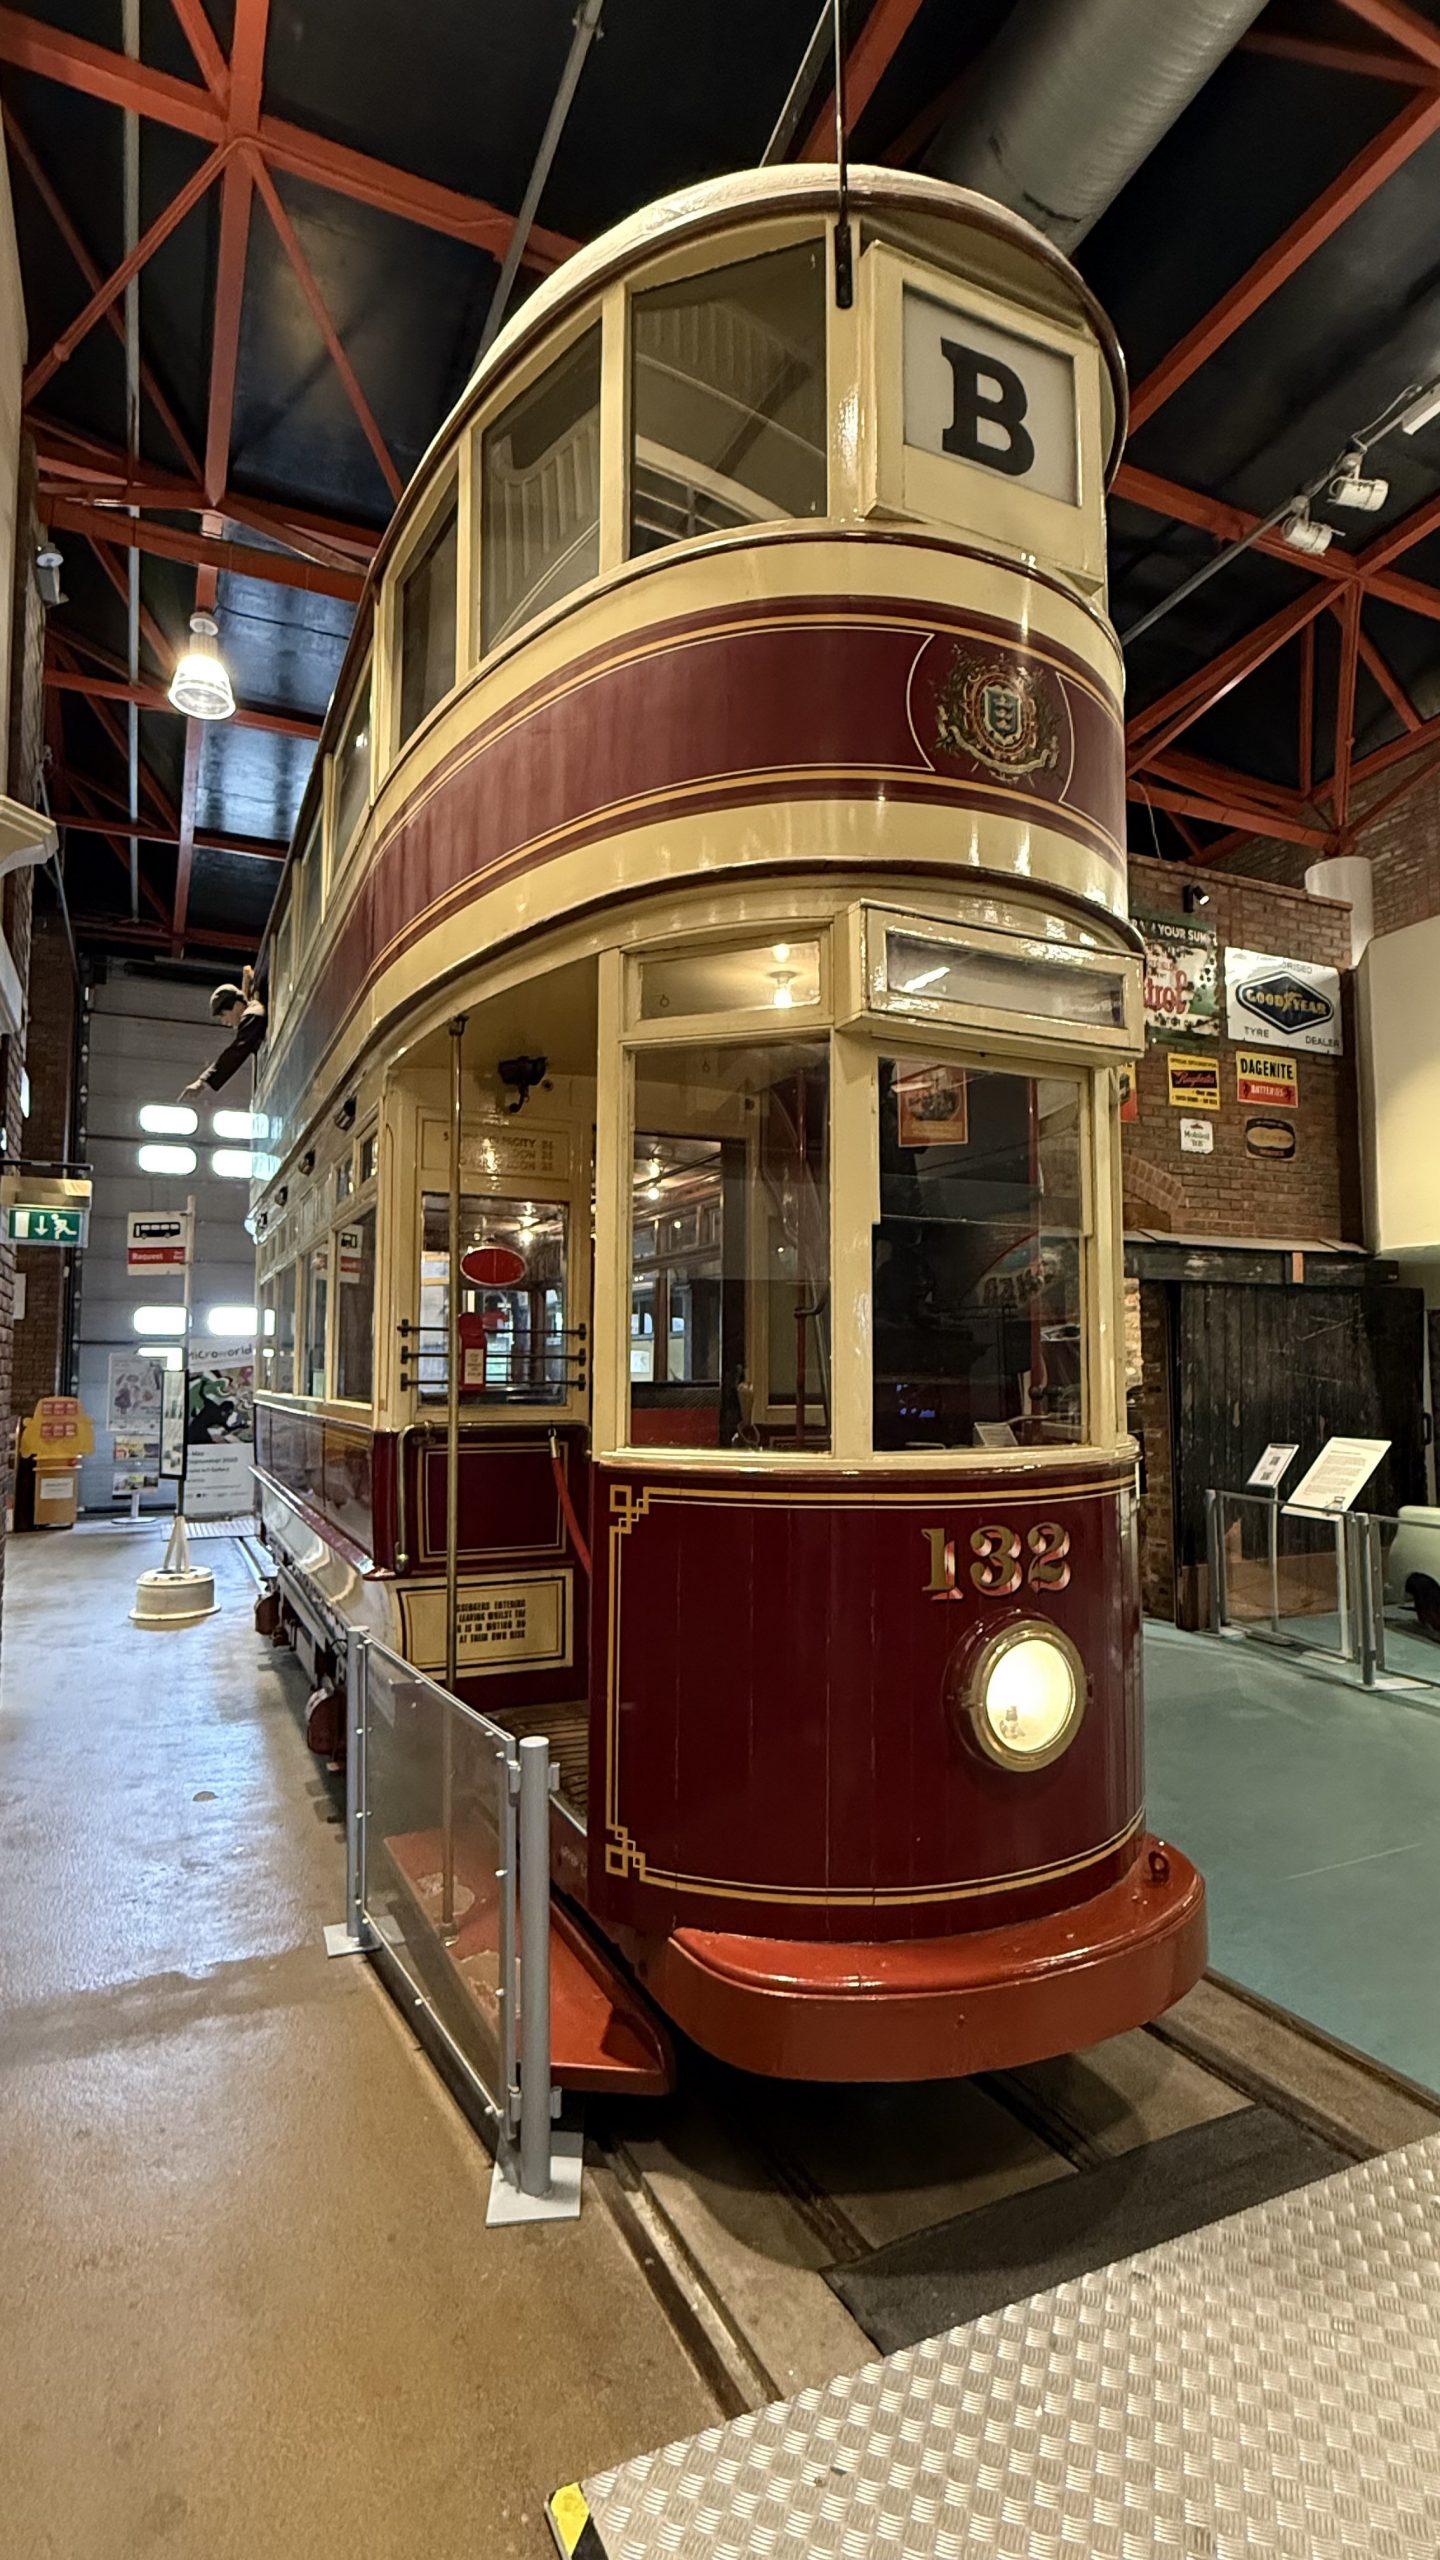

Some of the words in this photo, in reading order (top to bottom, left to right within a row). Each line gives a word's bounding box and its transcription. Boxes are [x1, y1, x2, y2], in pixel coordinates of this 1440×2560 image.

[940, 336, 1035, 477] B
[1157, 923, 1186, 940] YOUR
[1245, 988, 1327, 1016] GOODYEAR
[1244, 1026, 1270, 1038] TYRE
[1305, 1035, 1340, 1048] DEALER
[1240, 1058, 1294, 1080] DAGENITE
[132, 1252, 164, 1261] Request
[920, 1521, 1072, 1601] 132
[457, 1602, 490, 1612] SSENGERS
